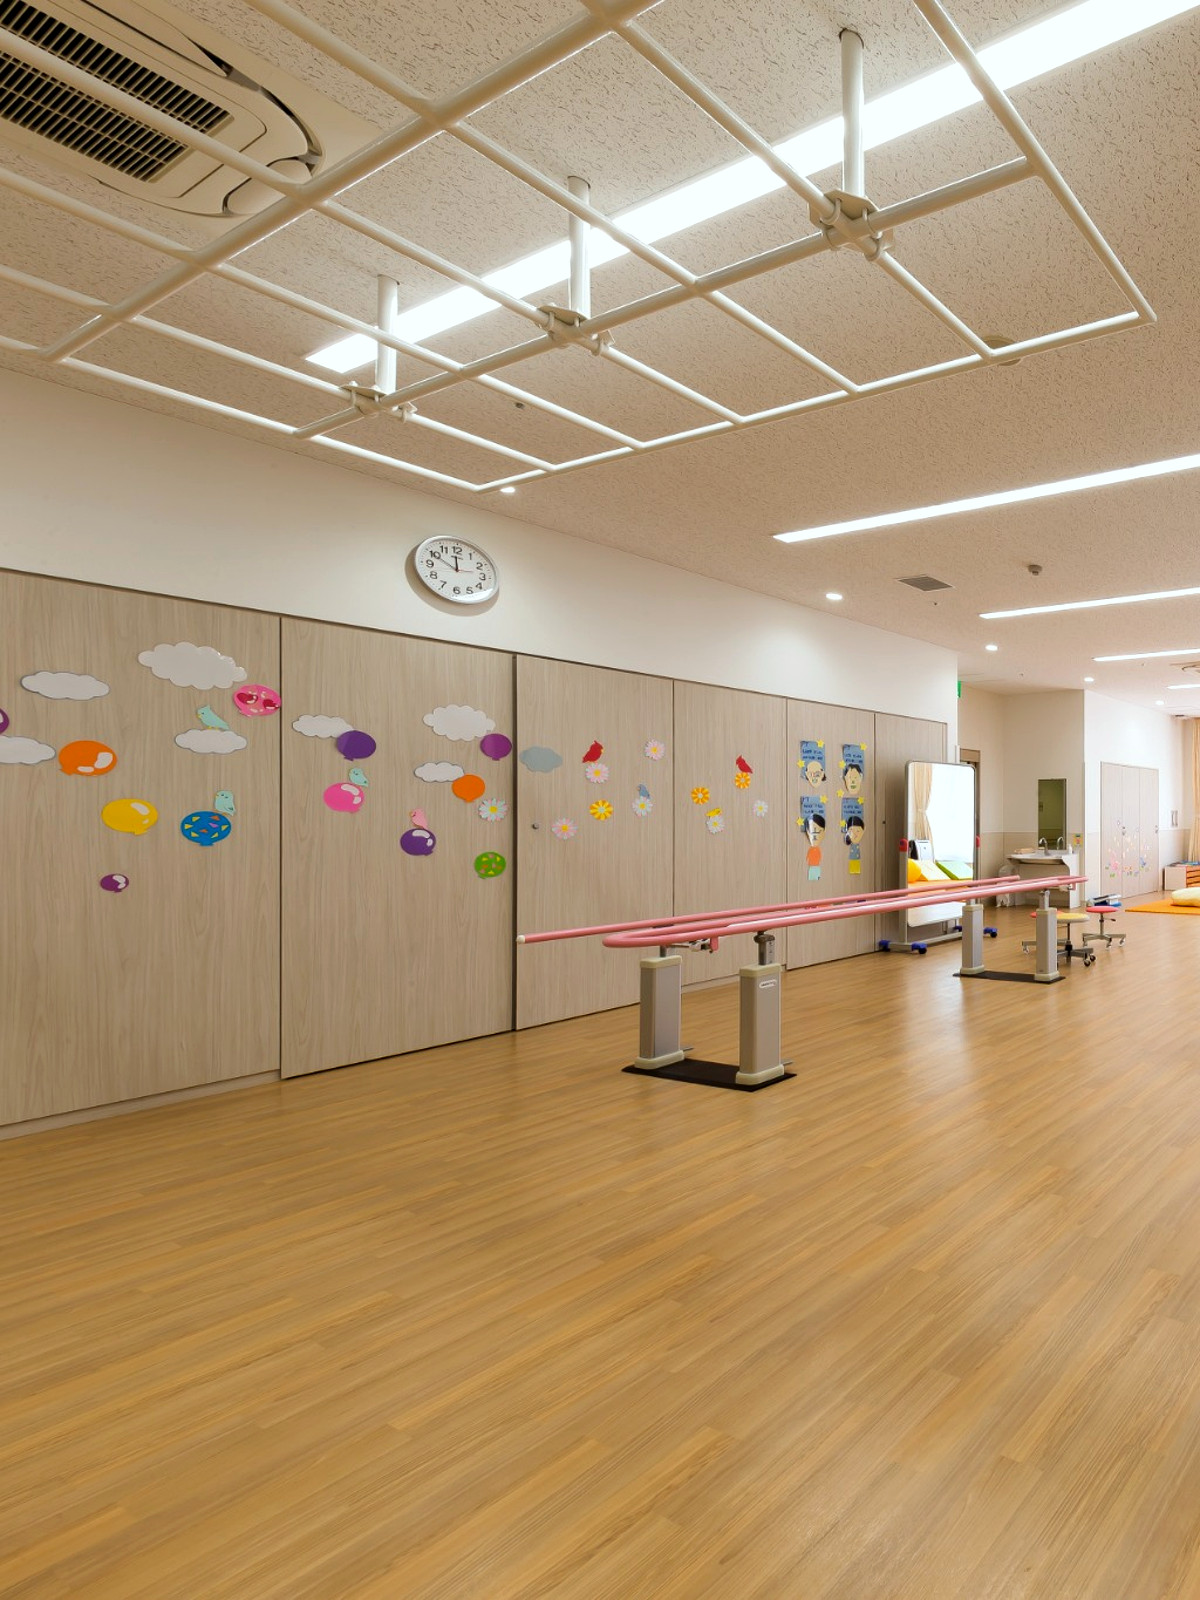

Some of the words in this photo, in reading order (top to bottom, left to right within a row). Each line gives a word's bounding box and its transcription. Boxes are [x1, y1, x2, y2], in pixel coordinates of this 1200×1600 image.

[440, 545, 448, 554] 11
[452, 546, 463, 555] 12
[429, 550, 441, 560] 10
[469, 552, 472, 560] 1
[426, 559, 434, 568] 9
[476, 562, 483, 570] 2
[430, 571, 437, 579] 8
[479, 573, 486, 581] 3
[440, 580, 447, 589] 7
[475, 582, 482, 590] 4
